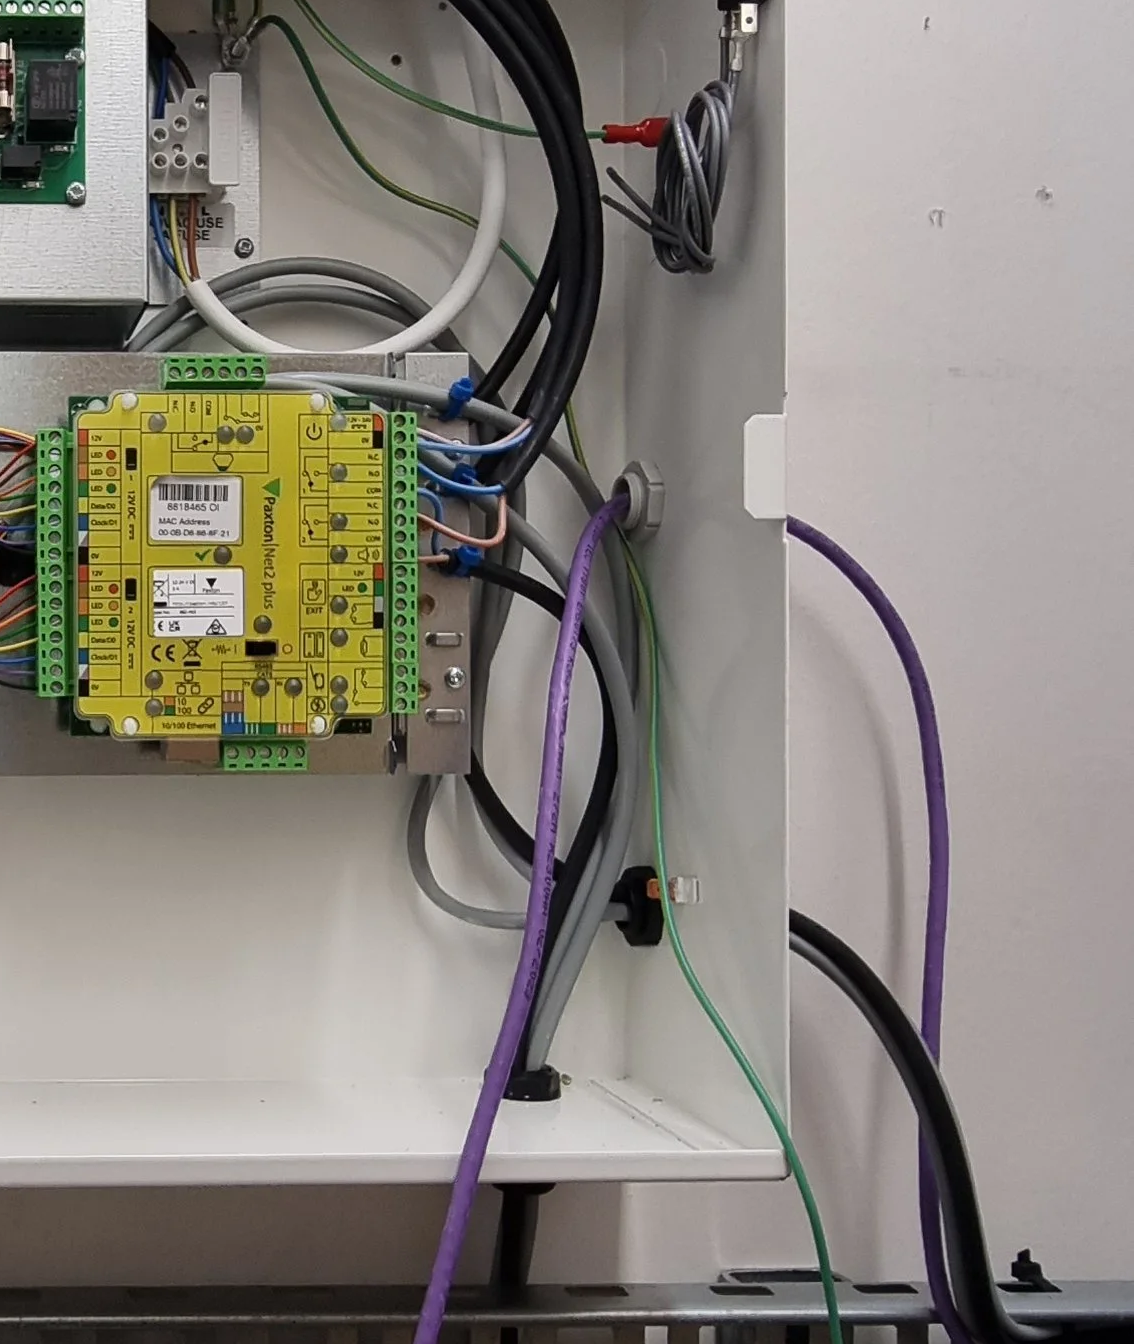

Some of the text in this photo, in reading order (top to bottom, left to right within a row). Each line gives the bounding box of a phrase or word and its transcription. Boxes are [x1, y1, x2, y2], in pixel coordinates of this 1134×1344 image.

[128, 507, 136, 519] DC
[261, 582, 276, 610] plus
[306, 607, 323, 615] EXIT
[127, 620, 135, 635] 12V
[127, 637, 135, 649] DC
[152, 644, 175, 662] CE
[187, 721, 216, 729] Ethernet
